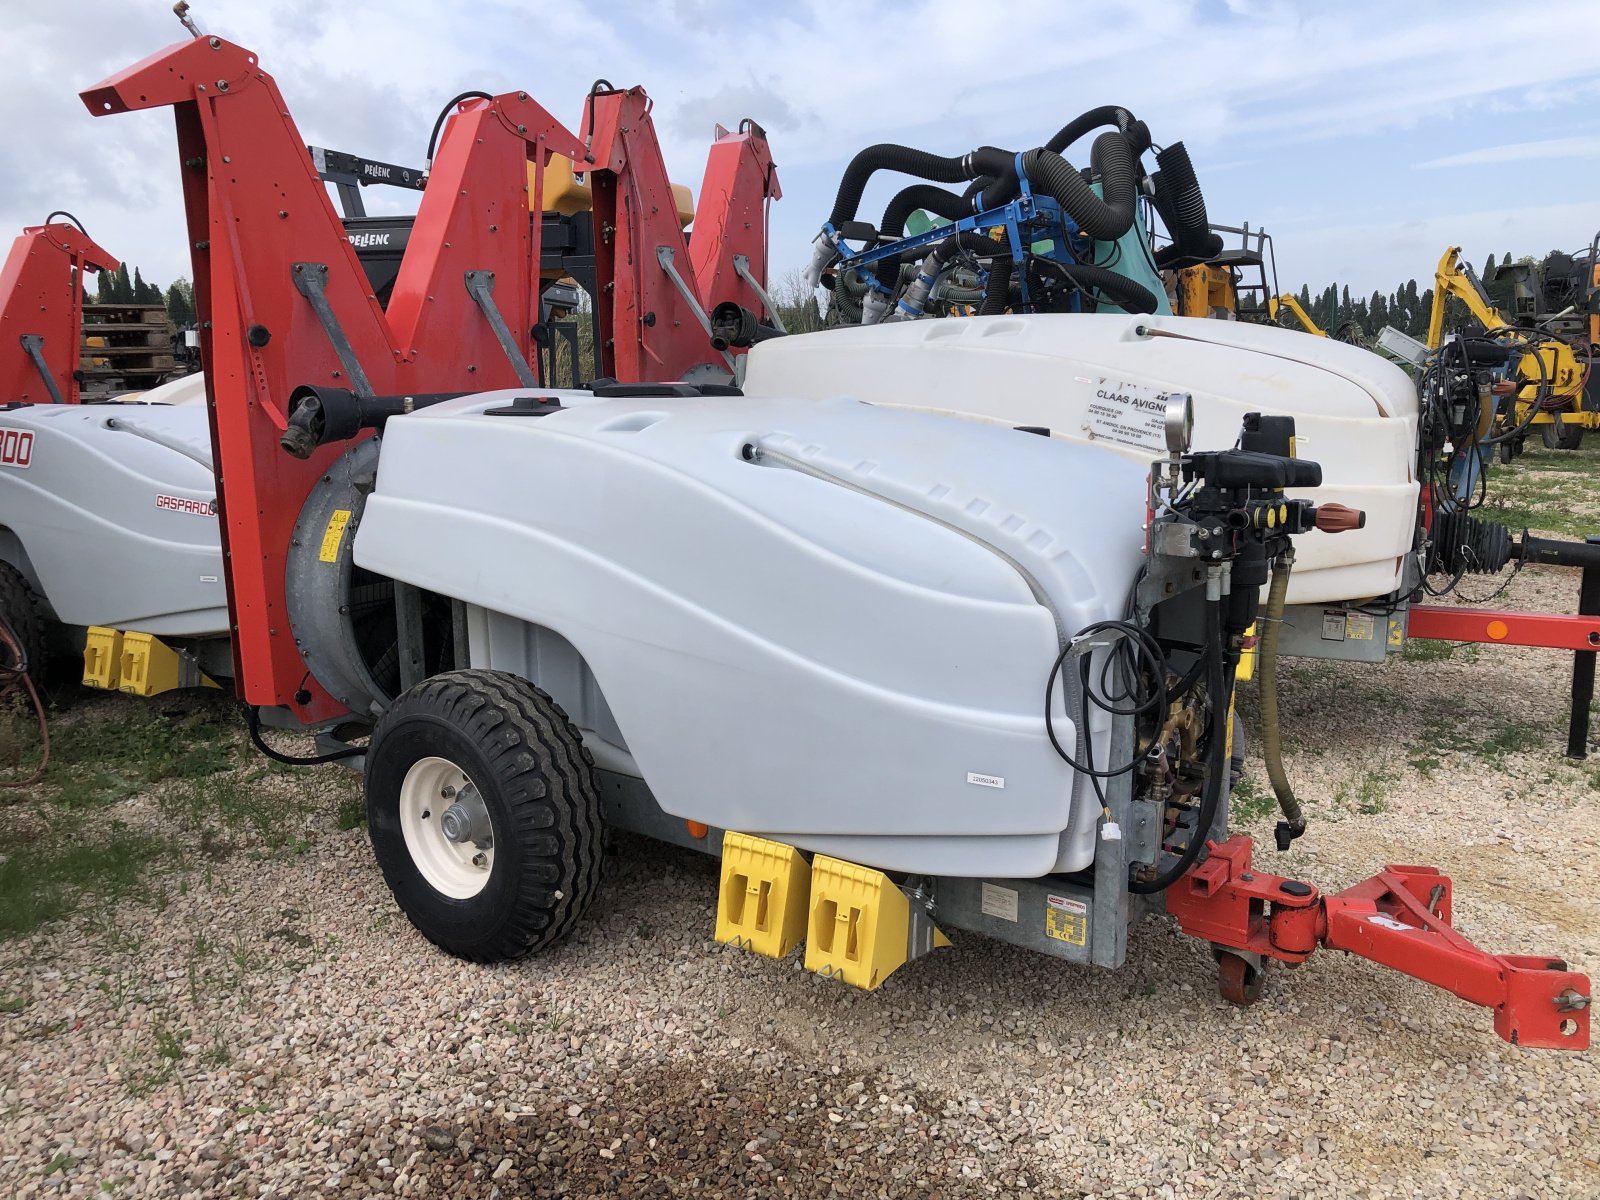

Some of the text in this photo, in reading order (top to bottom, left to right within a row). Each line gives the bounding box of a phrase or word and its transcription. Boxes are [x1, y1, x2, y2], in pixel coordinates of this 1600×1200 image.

[364, 164, 391, 178] PELLENC
[348, 233, 390, 248] PELLENC
[1096, 389, 1130, 404] CLAAS
